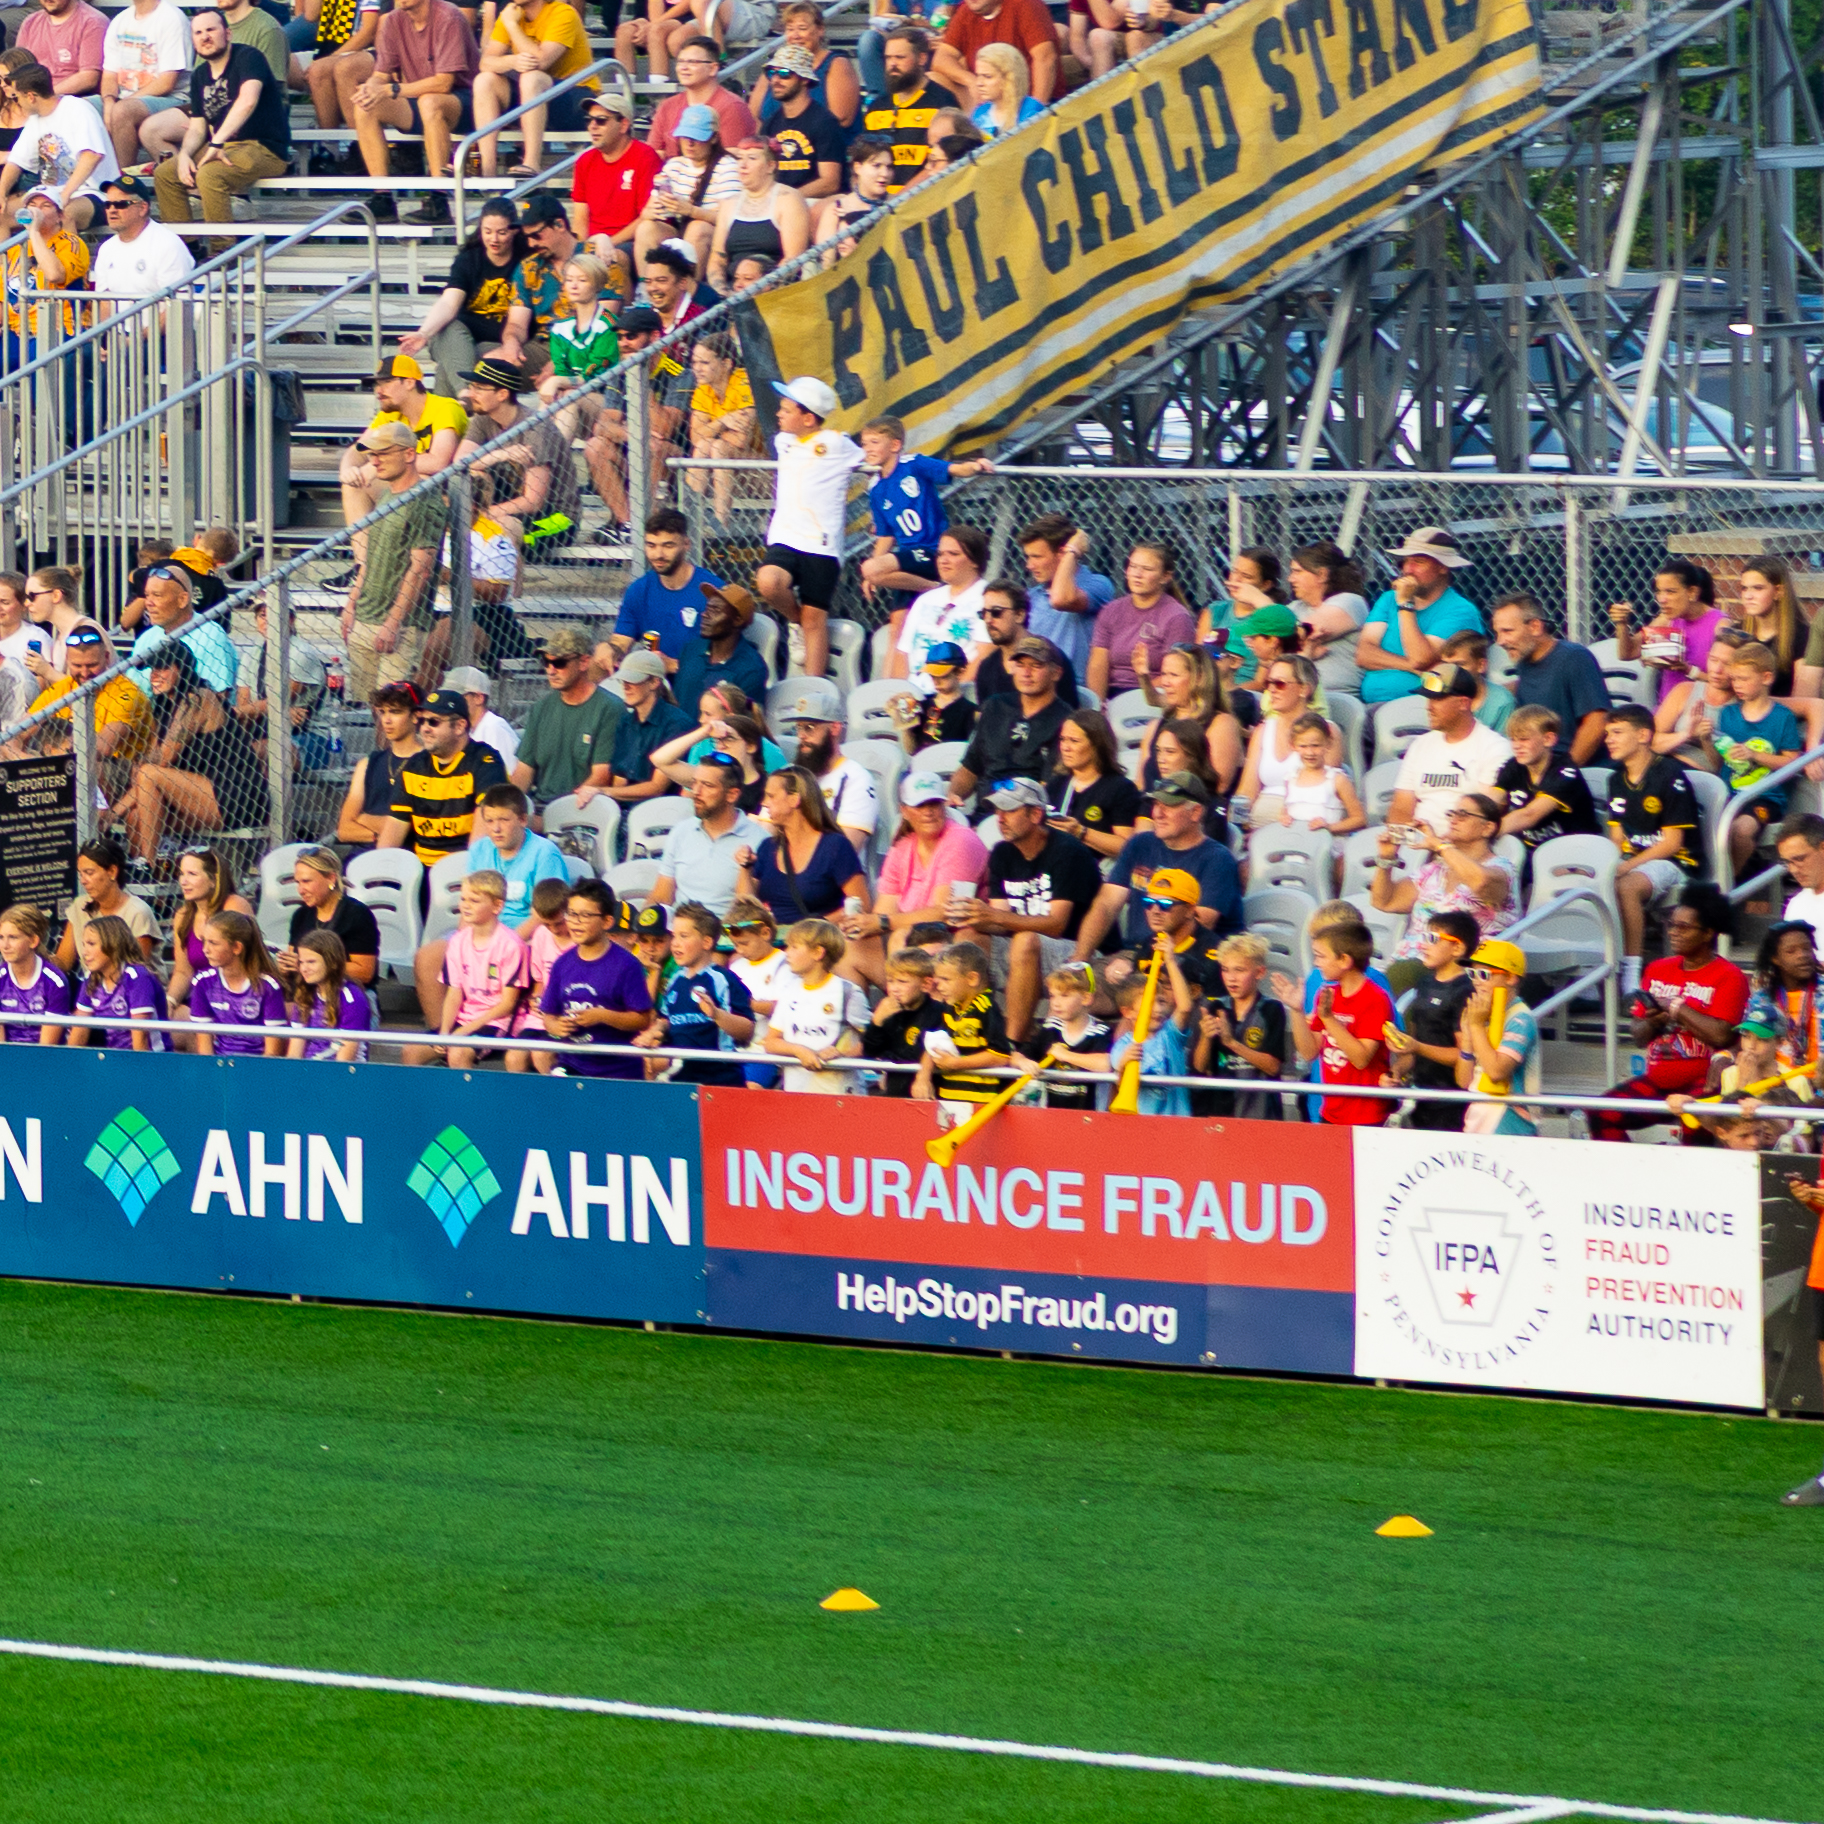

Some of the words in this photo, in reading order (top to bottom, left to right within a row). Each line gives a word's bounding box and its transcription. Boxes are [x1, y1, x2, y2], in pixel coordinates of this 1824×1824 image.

[827, 193, 1019, 410] PAUL
[1022, 55, 1242, 273] CHILD
[896, 508, 923, 537] 10
[6, 775, 67, 793] SUPPORTERS
[1421, 773, 1460, 788] PUMA
[18, 791, 58, 807] SECTION
[191, 1129, 363, 1224] AHN
[510, 1148, 690, 1246] AHN
[725, 1148, 1085, 1232] INSURANCE
[1103, 1174, 1328, 1246] FRAUD
[1375, 1150, 1545, 1257] COMMONWEALTH
[1539, 1233, 1559, 1270] OF
[1584, 1203, 1734, 1236] INSURANCE
[1436, 1242, 1500, 1275] IFPA
[1586, 1238, 1670, 1266] FRAUD
[837, 1272, 1178, 1348] HelpStopFraud.org
[1586, 1276, 1743, 1311] PREVENTION
[1384, 1294, 1550, 1372] PENNSYLVANIA
[1587, 1313, 1733, 1345] AUTHORITY
